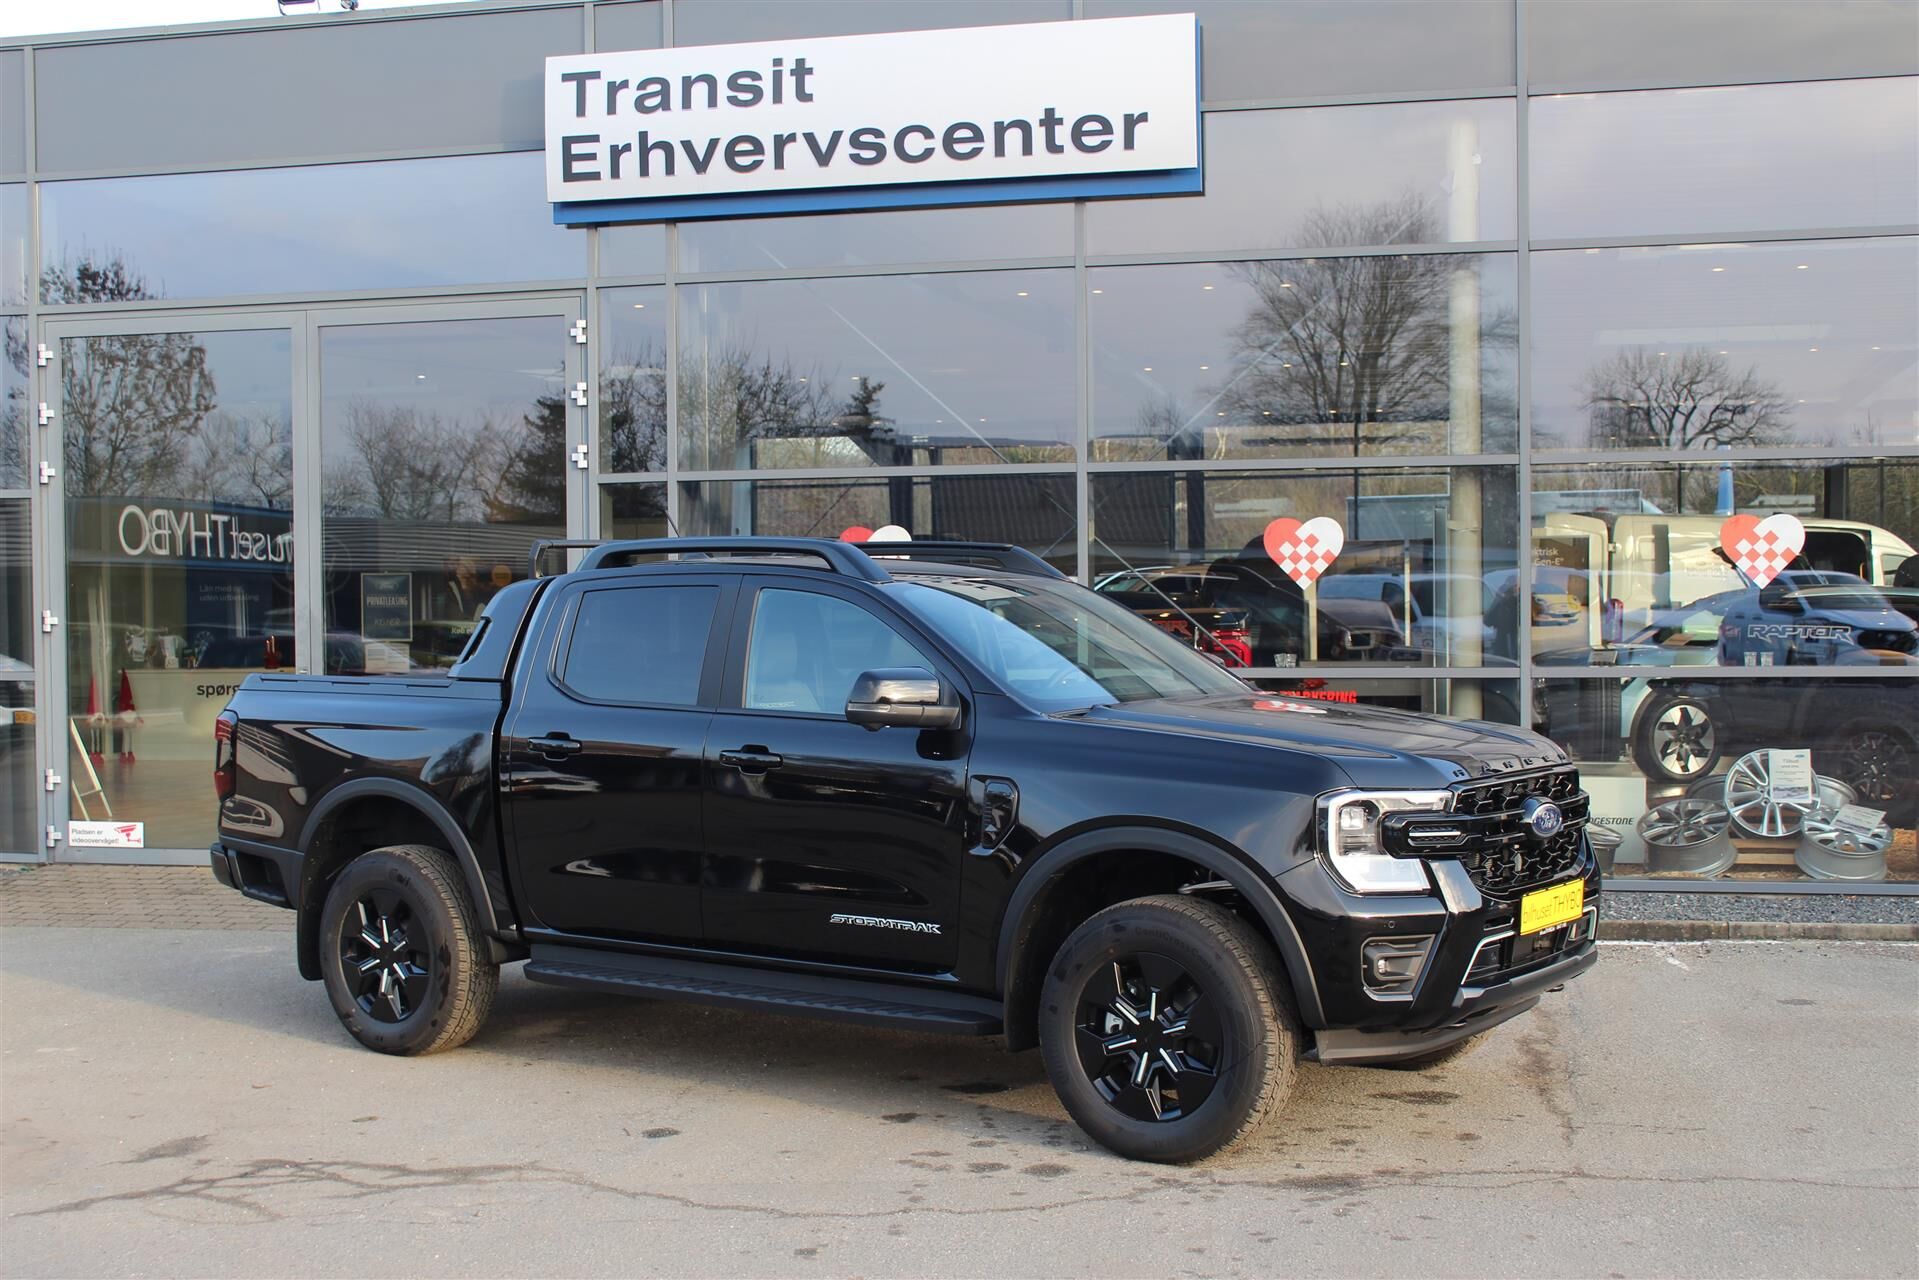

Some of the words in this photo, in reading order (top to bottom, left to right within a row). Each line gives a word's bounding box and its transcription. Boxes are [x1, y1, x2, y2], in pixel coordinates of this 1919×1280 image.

[561, 58, 814, 118] Transit
[562, 107, 1148, 183] Erhvervscenter
[1748, 624, 1854, 646] RAPTOR
[830, 913, 941, 935] STORMTRAK
